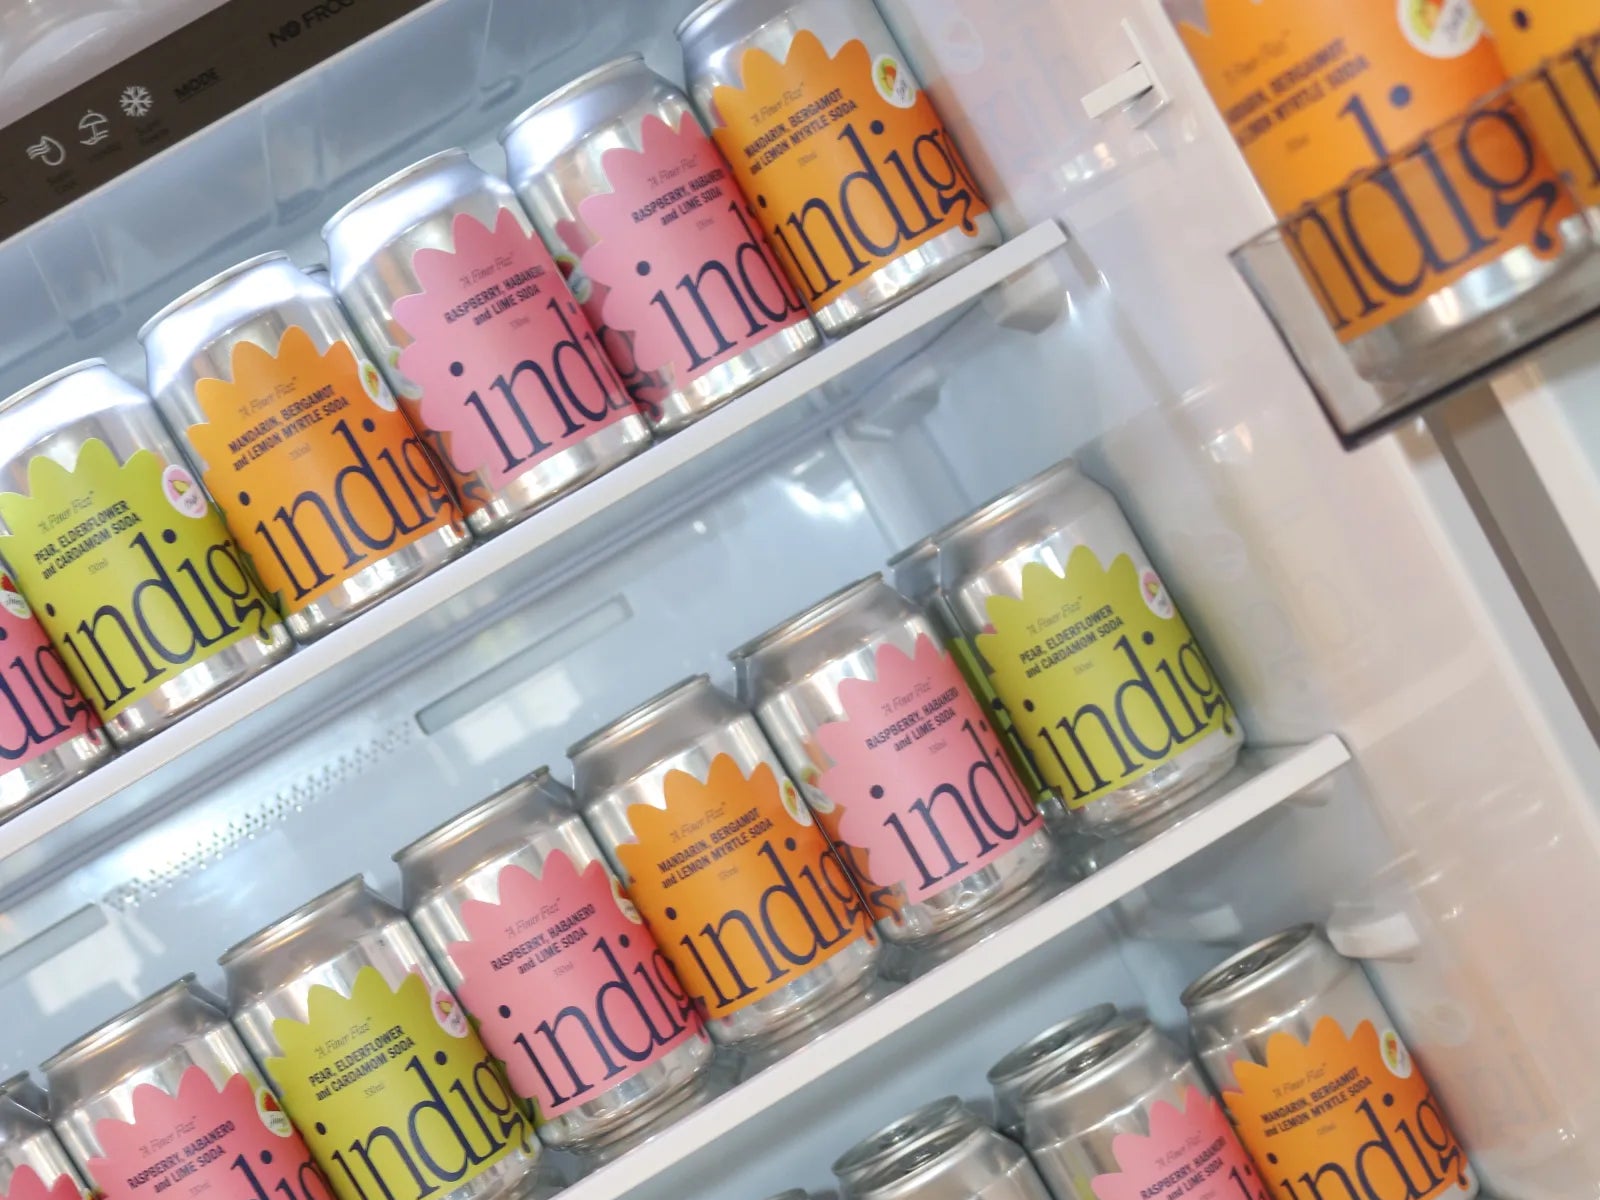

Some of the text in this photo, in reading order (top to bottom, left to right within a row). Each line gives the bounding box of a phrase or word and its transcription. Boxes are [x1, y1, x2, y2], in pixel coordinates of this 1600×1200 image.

[757, 119, 978, 301] indig
[239, 417, 466, 601] indig
[46, 529, 275, 709] indig
[1040, 631, 1098, 670] CARDAMOM
[1095, 615, 1124, 638] SODA
[1044, 604, 1114, 650] ELDERFLOWER
[911, 719, 936, 740] LIME
[933, 706, 957, 726] SODA
[1023, 631, 1234, 799] indig
[748, 817, 774, 838] SODA
[534, 941, 562, 963] LIME
[559, 926, 588, 948] SODA
[665, 837, 876, 1008] indig
[333, 1025, 405, 1072] ELDERFLOWER
[499, 934, 706, 1108] indig
[330, 1052, 388, 1092] CARDAMOM
[386, 1036, 416, 1059] SODA
[170, 1161, 198, 1183] LIME
[196, 1144, 226, 1167] SODA
